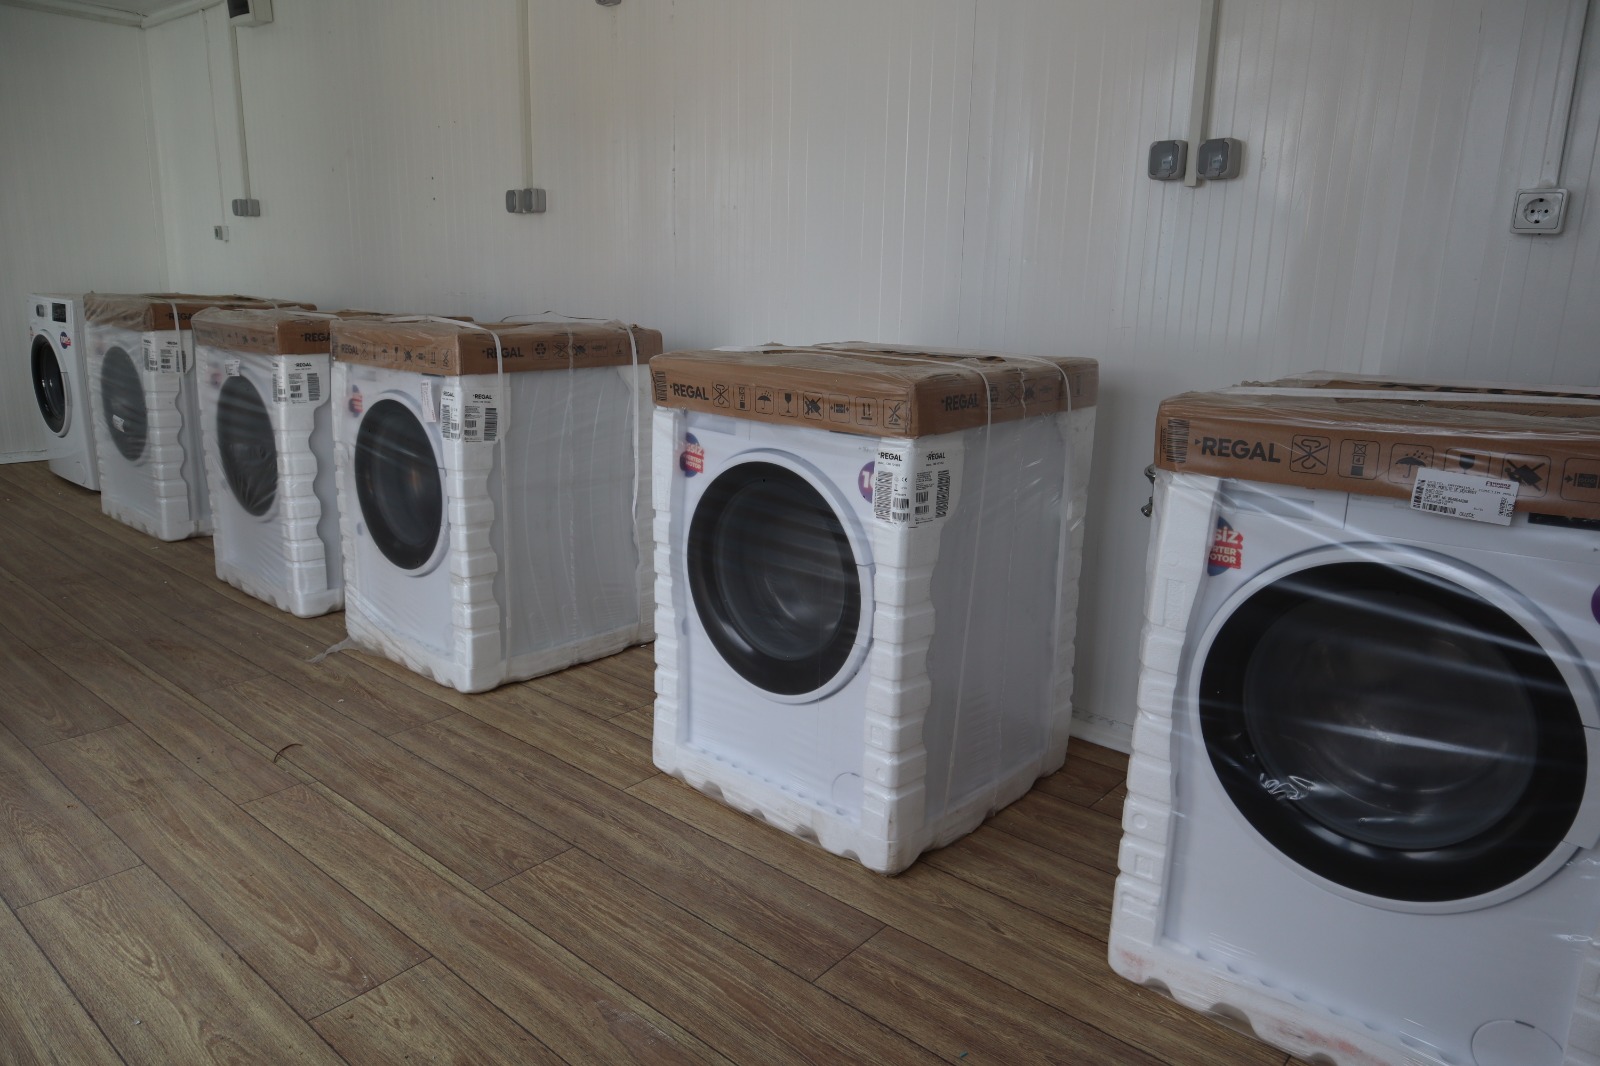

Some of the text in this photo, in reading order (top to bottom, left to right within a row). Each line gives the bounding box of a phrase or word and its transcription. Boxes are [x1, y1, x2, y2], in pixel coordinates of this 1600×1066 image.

[673, 382, 709, 401] REGAL
[945, 392, 980, 411] REGAL
[879, 451, 903, 462] REGAL
[927, 452, 946, 461] REGAL
[1201, 436, 1281, 464] REGAL
